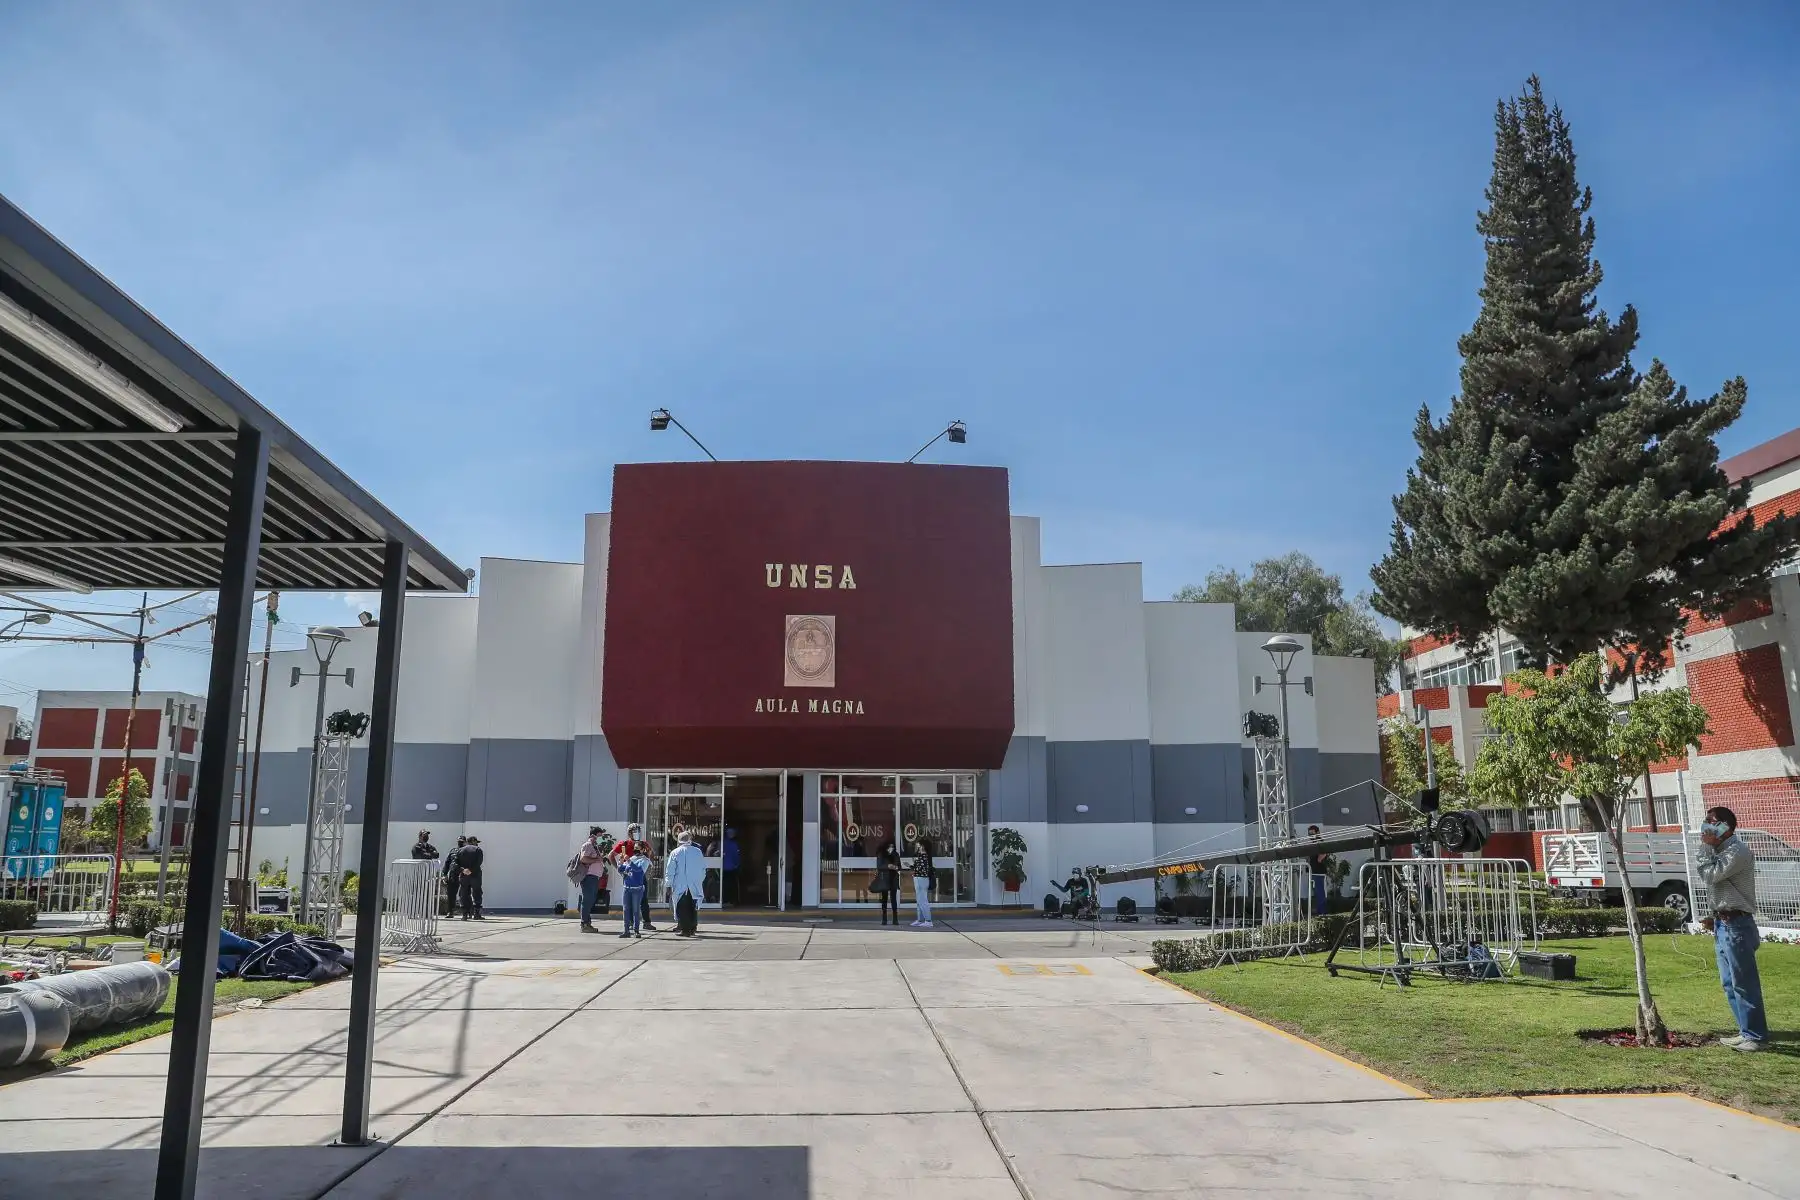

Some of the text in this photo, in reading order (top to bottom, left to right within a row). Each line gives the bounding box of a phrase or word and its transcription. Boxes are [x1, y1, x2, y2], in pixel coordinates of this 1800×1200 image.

[765, 563, 857, 589] UNSA
[755, 698, 865, 715] AULA MAGNA
